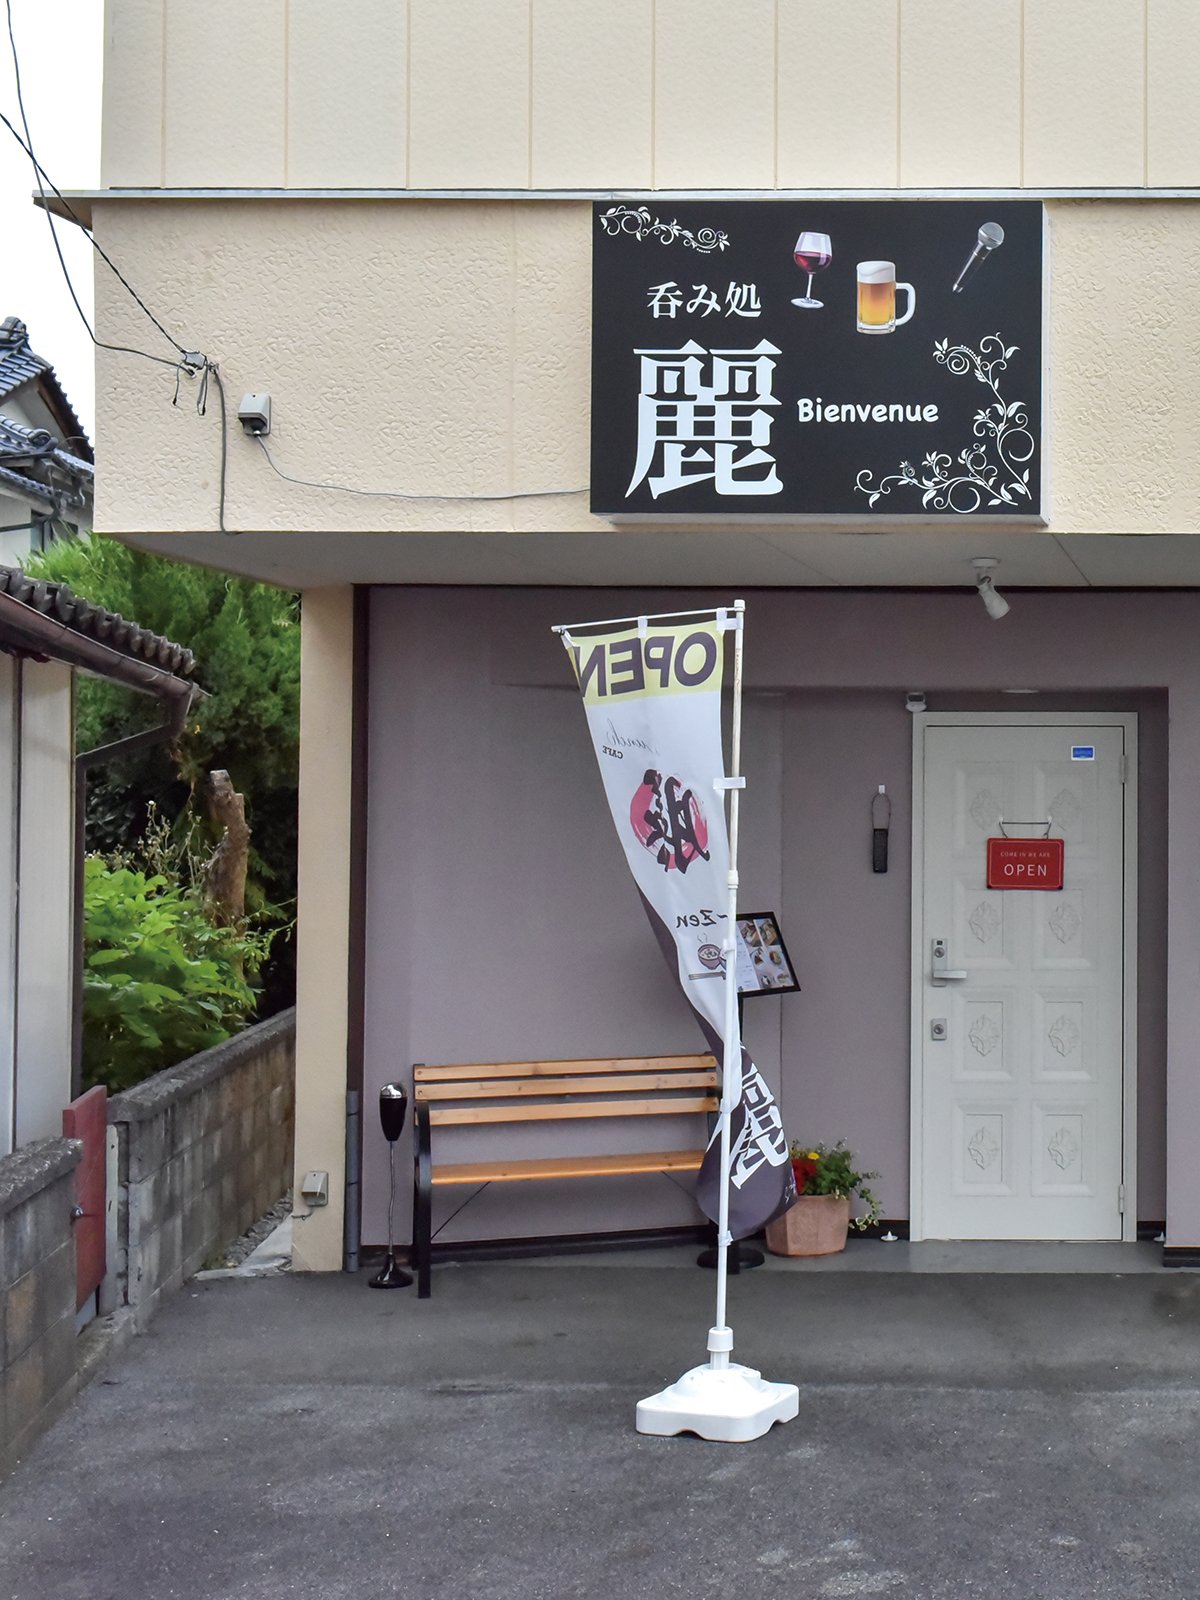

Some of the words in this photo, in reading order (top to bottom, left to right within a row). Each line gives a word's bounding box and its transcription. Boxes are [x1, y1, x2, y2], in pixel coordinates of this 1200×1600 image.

[646, 281, 762, 319] 呑み処
[625, 338, 784, 500] 麗
[797, 397, 940, 423] Bienvenue
[1004, 863, 1047, 876] OPEN
